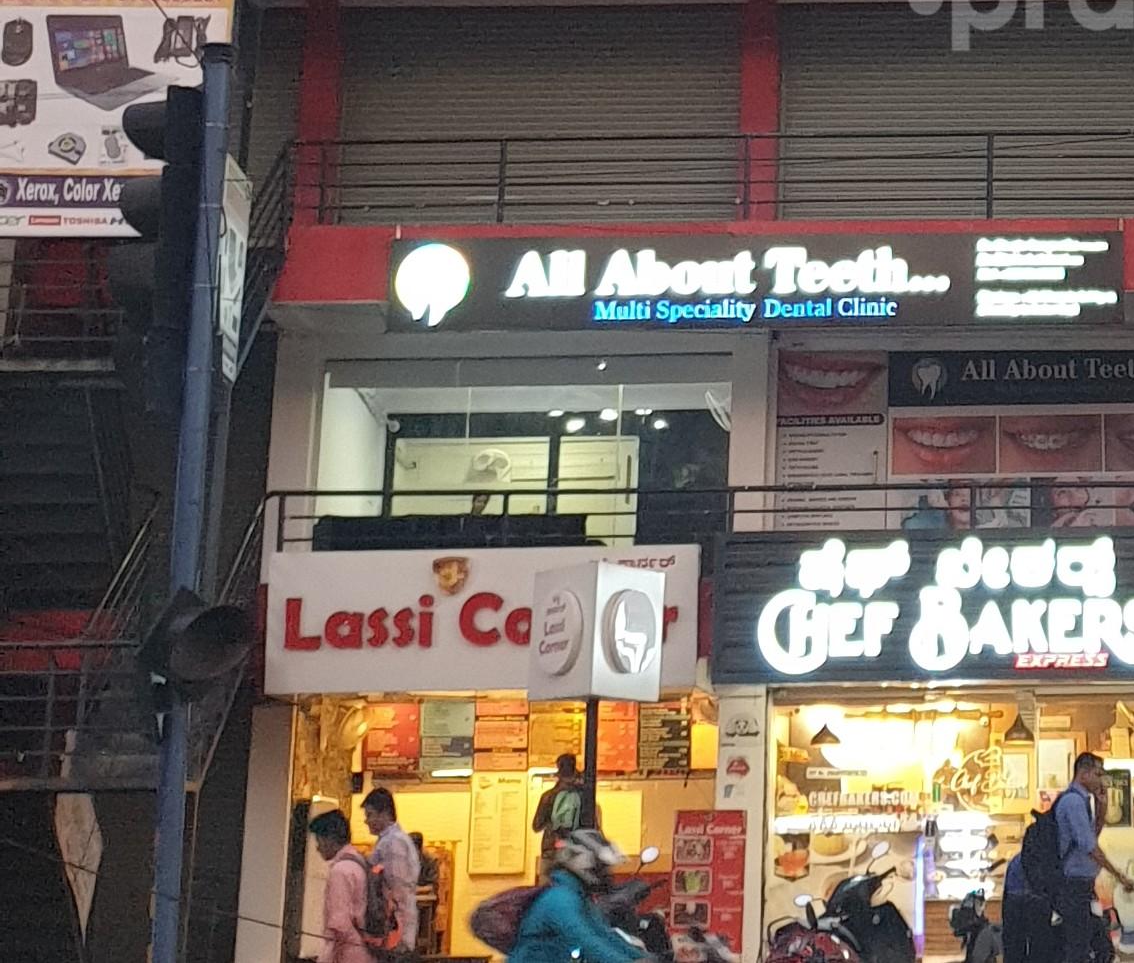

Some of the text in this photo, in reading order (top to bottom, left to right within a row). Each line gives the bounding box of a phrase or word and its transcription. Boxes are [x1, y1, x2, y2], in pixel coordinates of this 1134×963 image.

[16, 177, 59, 205] Xerox,
[63, 177, 101, 202] Color
[503, 249, 588, 297] All
[594, 247, 760, 297] About
[593, 296, 899, 323] Multi Speciality Dental Clinic
[960, 359, 997, 382] All
[1004, 358, 1079, 382] About
[284, 592, 679, 651] Lassi Cor
[1015, 653, 1108, 668] EXPRESS
